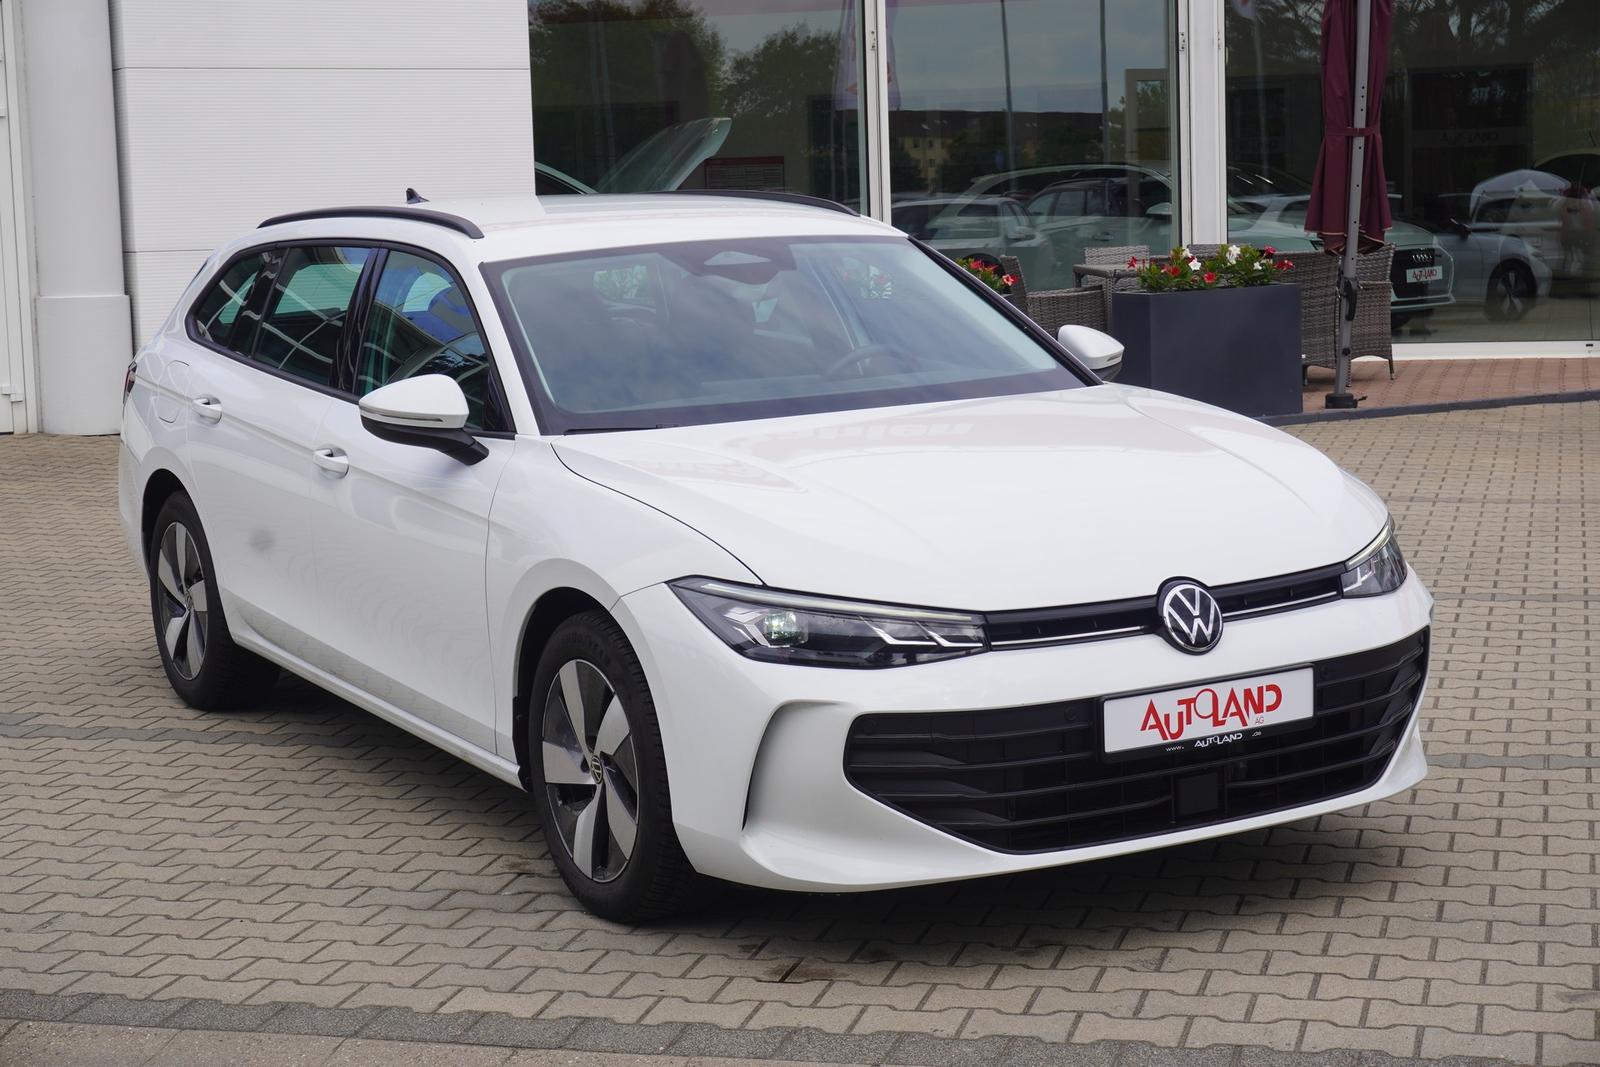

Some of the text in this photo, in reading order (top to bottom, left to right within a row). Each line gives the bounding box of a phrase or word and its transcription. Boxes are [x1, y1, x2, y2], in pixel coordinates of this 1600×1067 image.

[1163, 584, 1222, 651] VW
[1140, 684, 1282, 741] AUTOLAND
[1255, 716, 1265, 725] AG
[1194, 733, 1242, 748] AUTOLAND
